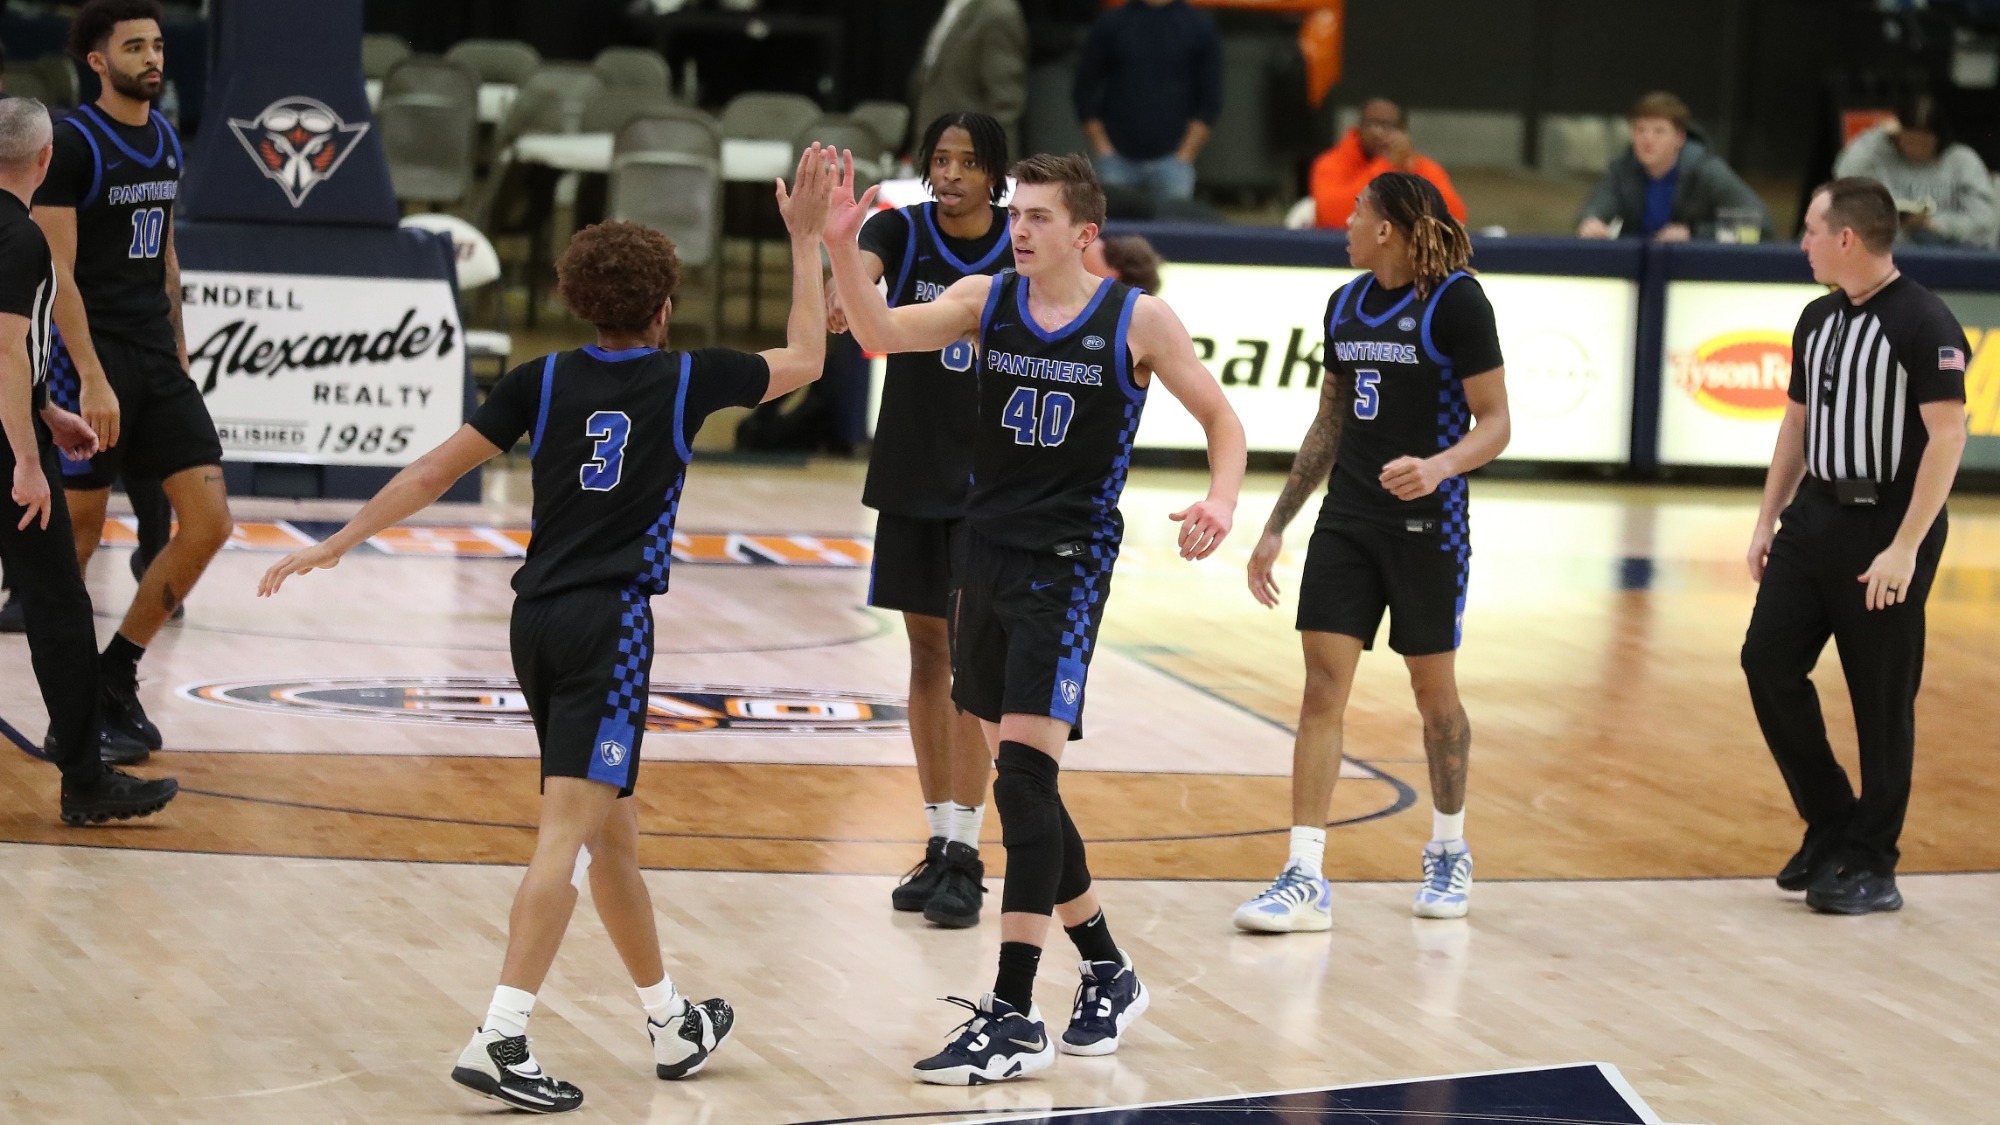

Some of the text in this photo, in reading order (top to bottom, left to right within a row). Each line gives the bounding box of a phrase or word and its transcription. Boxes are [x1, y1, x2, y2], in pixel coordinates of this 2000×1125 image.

[109, 180, 178, 205] PANTHER
[129, 207, 165, 258] 10
[188, 307, 456, 396] Alexander
[988, 350, 1103, 386] PANTHERS
[1672, 352, 1760, 394] Tyson
[313, 383, 432, 408] REALTY
[1002, 386, 1075, 447] 40
[1354, 368, 1381, 420] 5
[318, 424, 416, 455] 1985
[580, 410, 631, 491] 3
